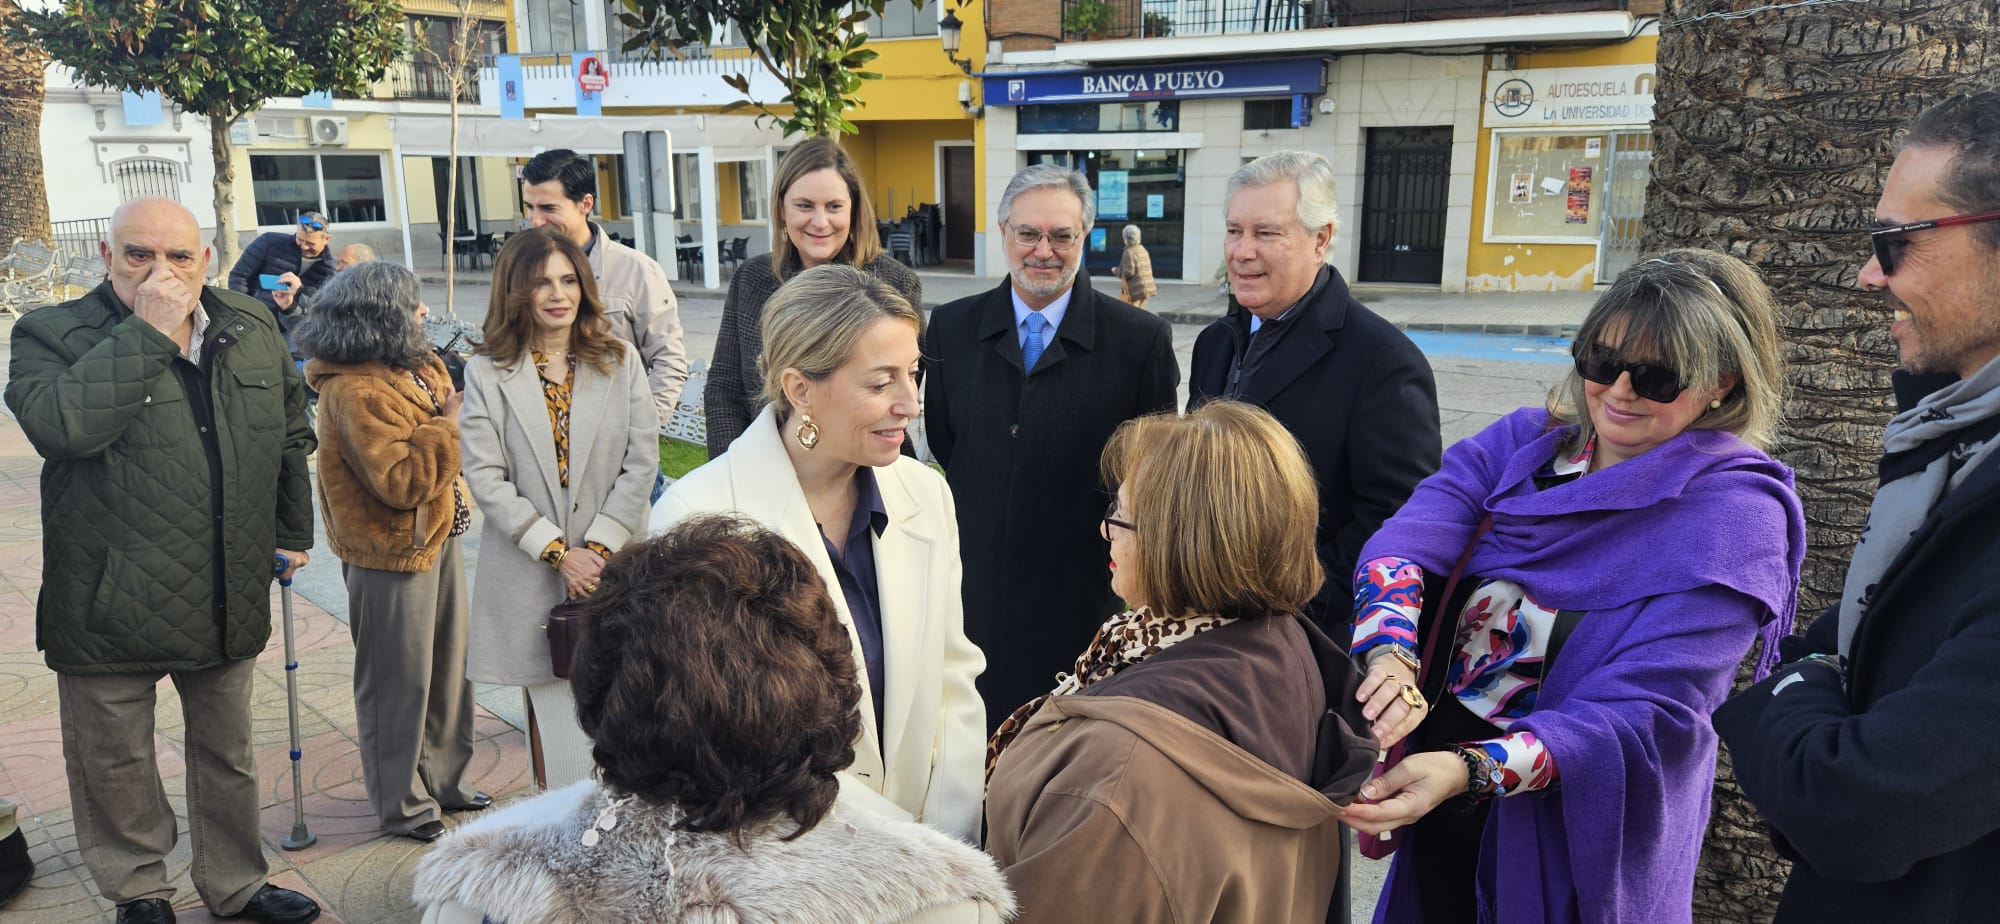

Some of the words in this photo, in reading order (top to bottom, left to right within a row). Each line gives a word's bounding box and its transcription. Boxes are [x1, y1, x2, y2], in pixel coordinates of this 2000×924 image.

[1082, 74, 1149, 94] BANCA
[1154, 70, 1225, 90] PUEYO
[1547, 81, 1627, 98] AUTOESCUELA
[1562, 104, 1631, 120] UNIVERSIDAD
